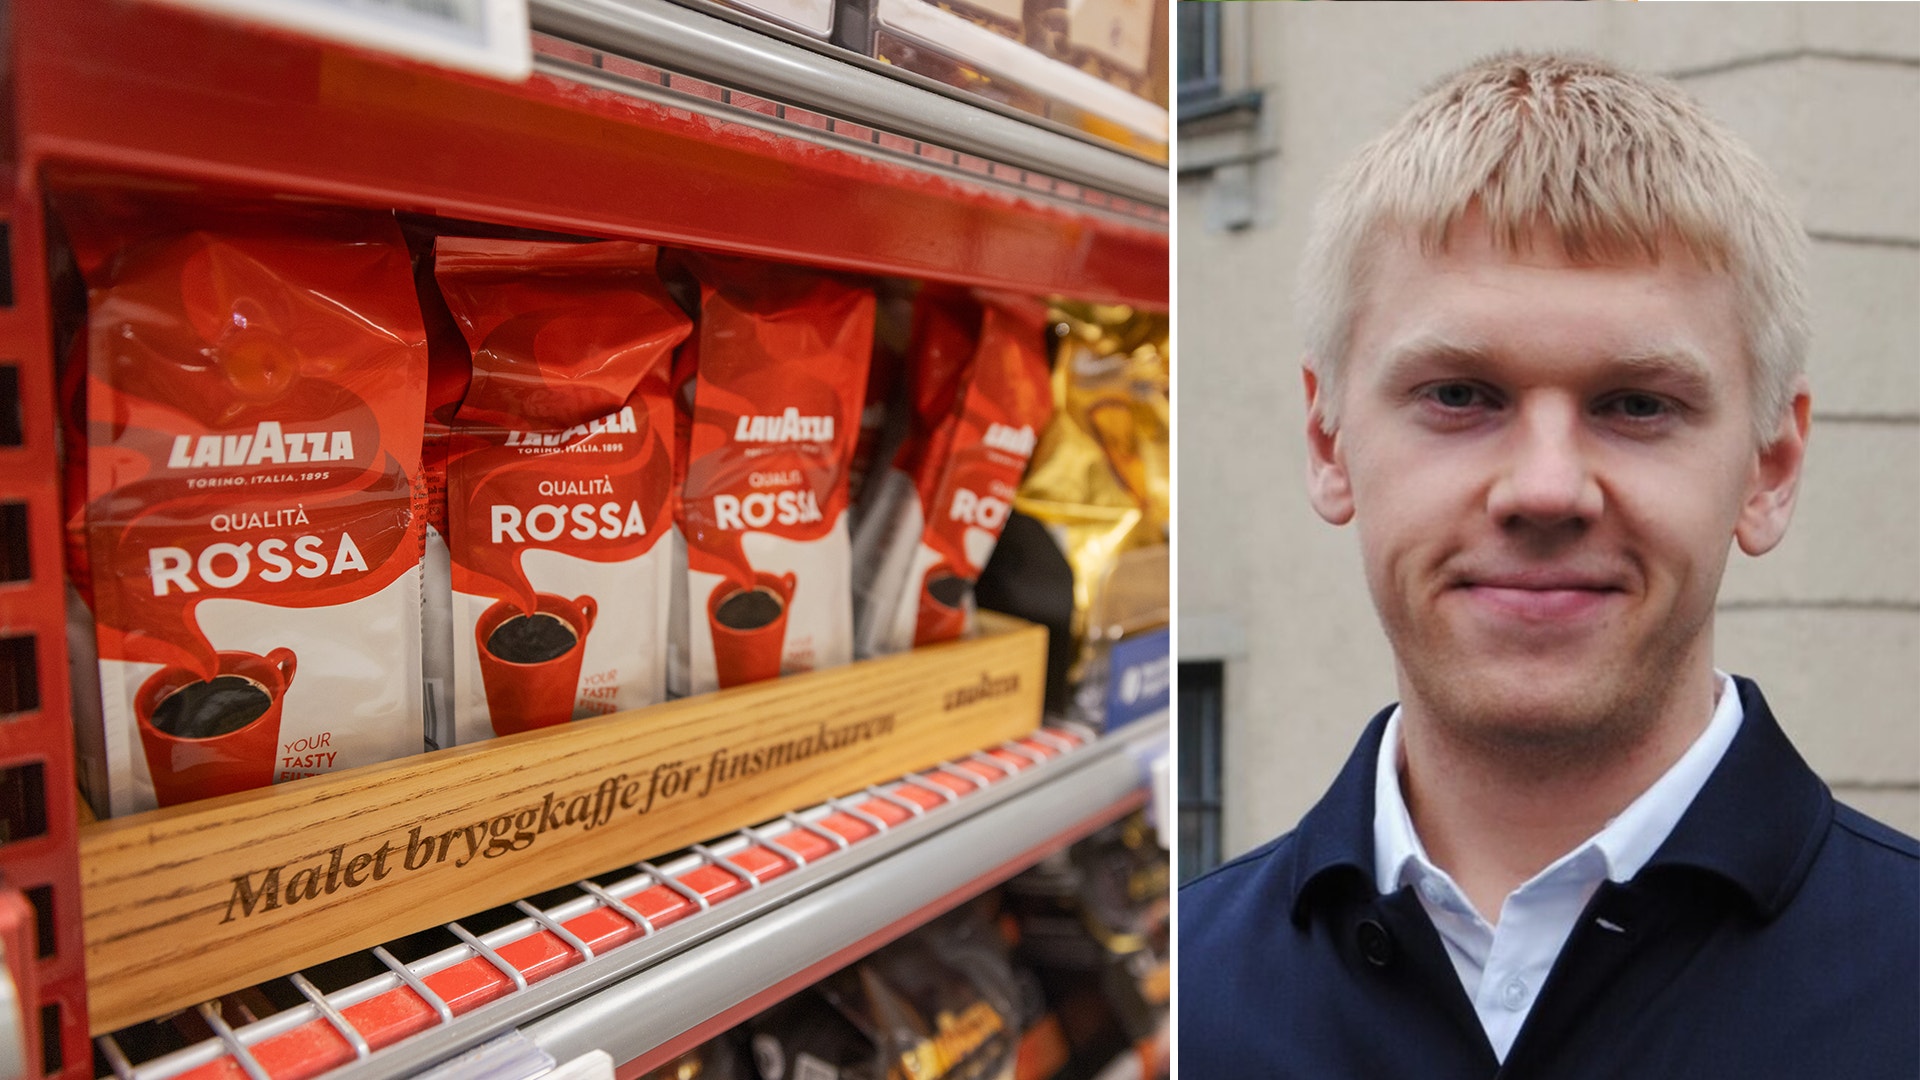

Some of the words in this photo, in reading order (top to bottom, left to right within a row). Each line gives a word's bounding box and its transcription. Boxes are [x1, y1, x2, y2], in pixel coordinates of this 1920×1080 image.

[167, 421, 354, 468] LAVAZZA
[602, 443, 623, 452] 1895
[300, 471, 330, 481] 1895
[538, 474, 614, 496] QUALITÀ
[210, 503, 310, 533] QUALITÀ
[490, 499, 647, 544] ROSSA
[149, 531, 369, 597] ROSSA
[284, 732, 331, 753] YOUR
[282, 751, 338, 768] TASTY
[219, 843, 393, 925] Malet
[403, 773, 640, 869] bryggkaffe
[638, 760, 702, 815] för
[698, 712, 895, 798] finsmakaren
